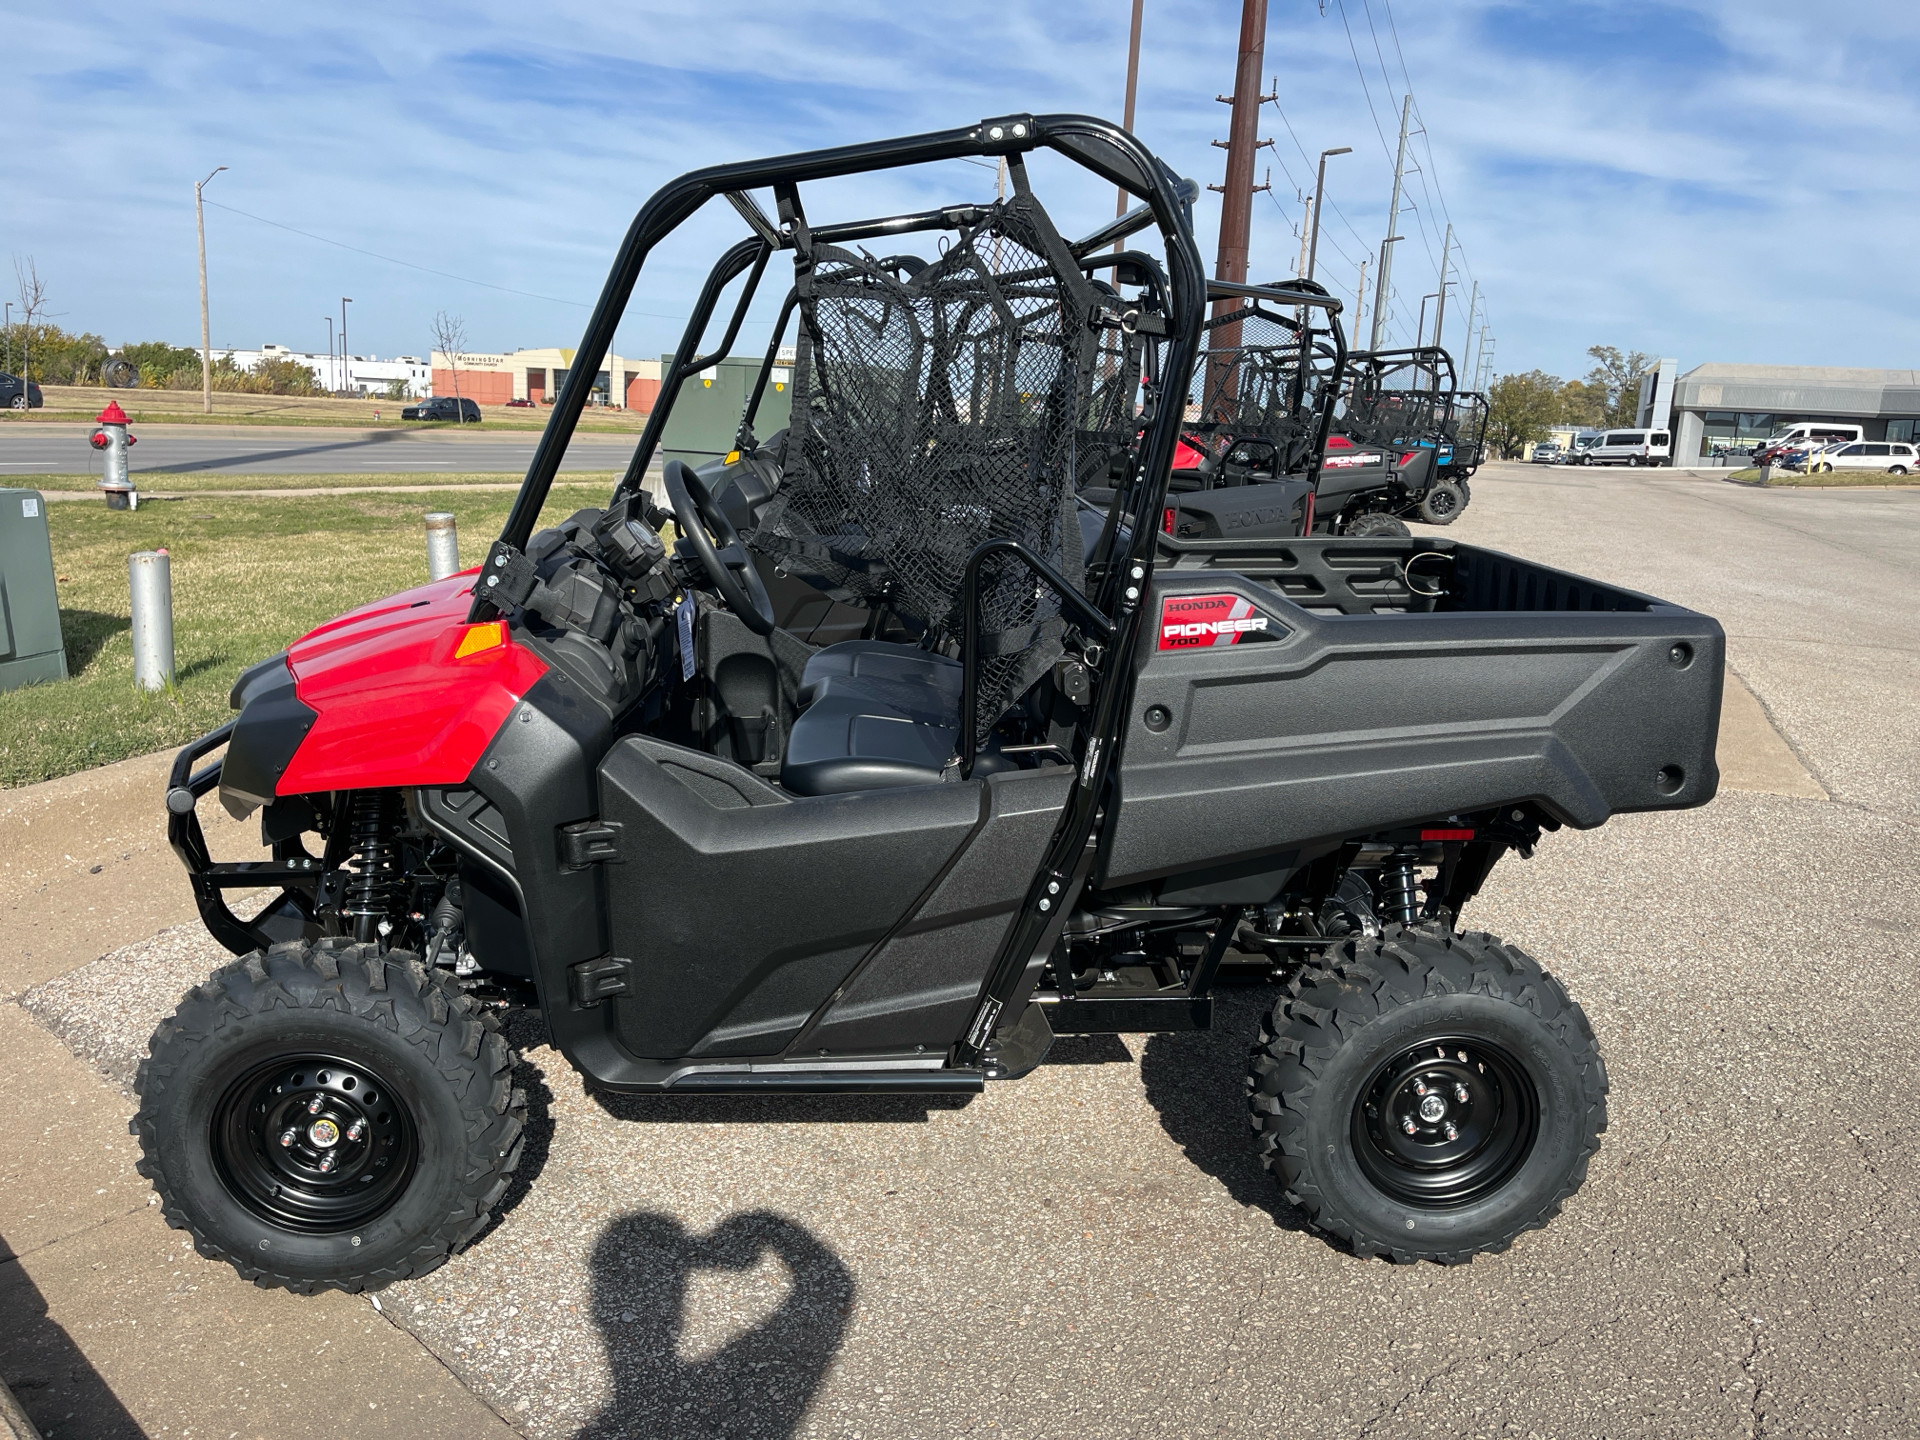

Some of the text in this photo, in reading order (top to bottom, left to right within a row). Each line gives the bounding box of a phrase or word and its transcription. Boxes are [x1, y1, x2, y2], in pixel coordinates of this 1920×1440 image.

[781, 349, 796, 357] SPE
[1327, 455, 1381, 465] PIONEER
[1225, 505, 1289, 530] HONDA
[1167, 600, 1229, 612] HONDA
[1164, 617, 1269, 638] PIONEER
[1166, 637, 1200, 646] 700
[1355, 1004, 1465, 1062] KENDA
